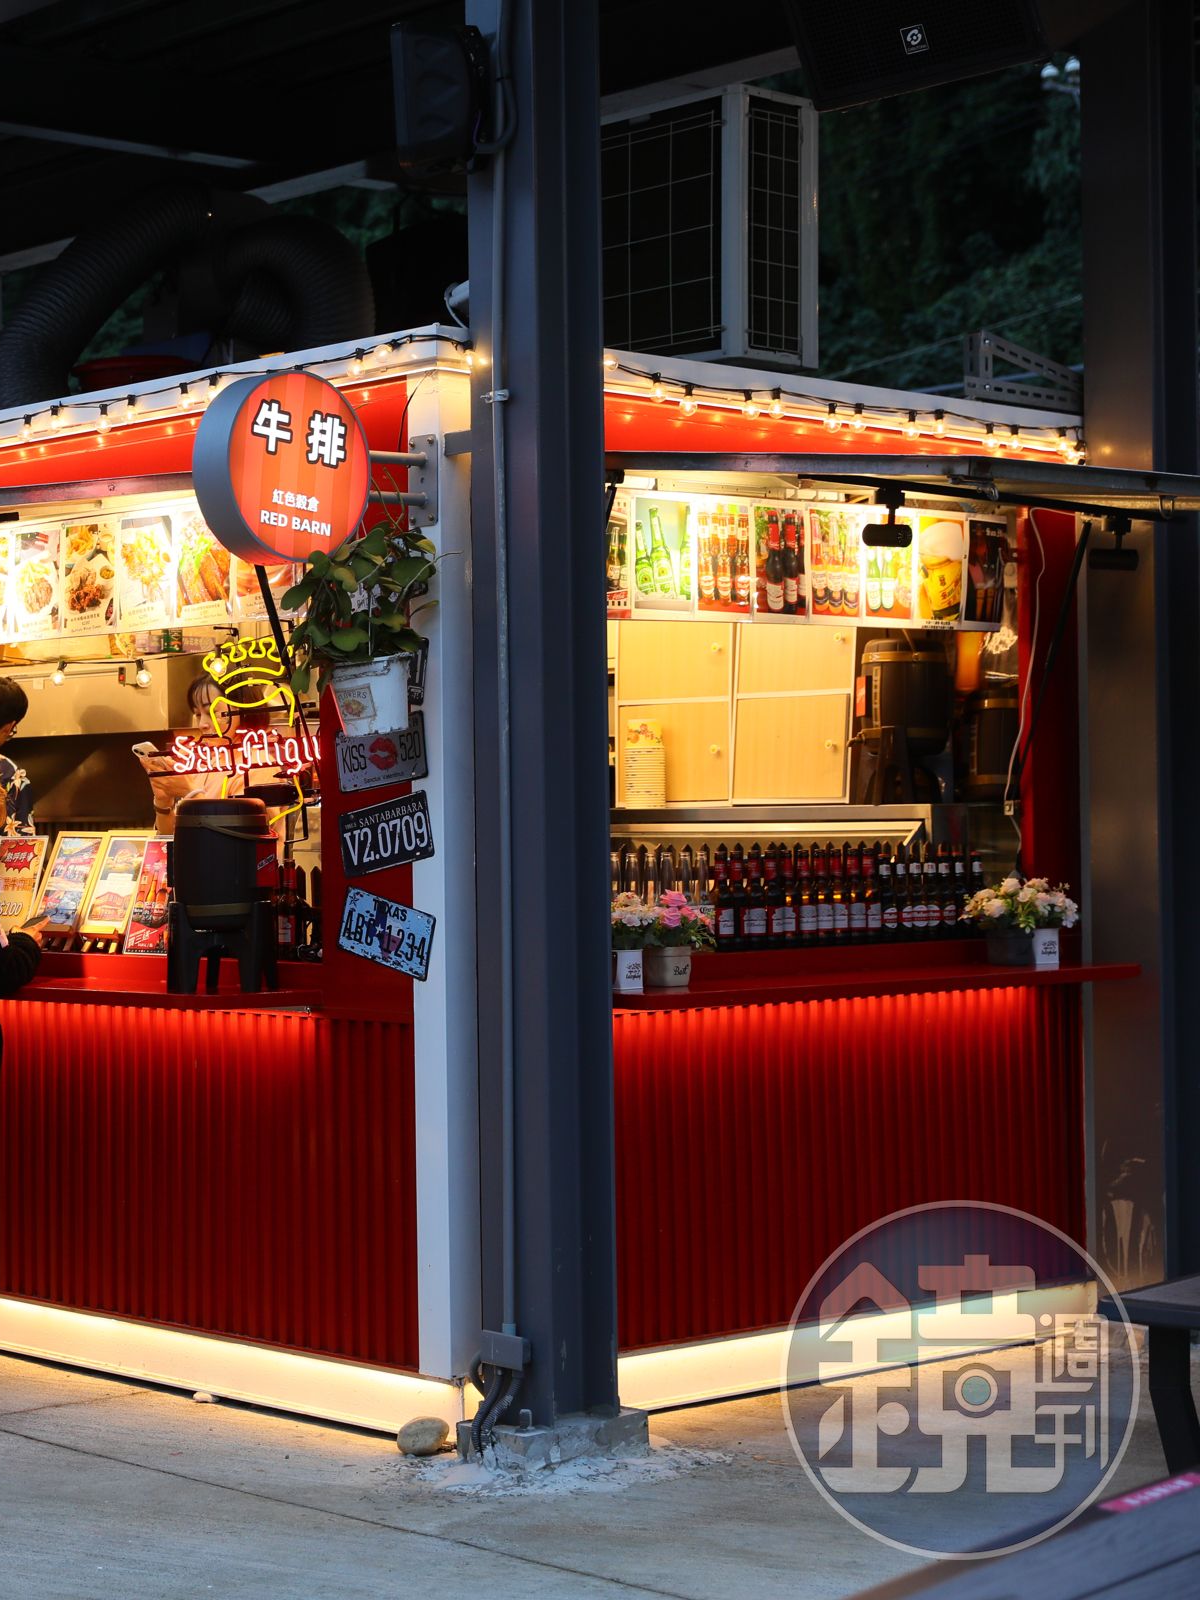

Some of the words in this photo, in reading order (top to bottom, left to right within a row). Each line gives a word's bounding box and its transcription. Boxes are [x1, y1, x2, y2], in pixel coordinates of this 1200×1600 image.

[252, 400, 347, 469] 牛排
[272, 489, 320, 513] 紅色穀倉
[260, 510, 288, 528] RED
[291, 517, 332, 537] BARN
[172, 735, 232, 773] San
[341, 743, 368, 774] KISS
[399, 731, 421, 761] 520
[358, 801, 424, 828] SANTABARBARA
[343, 811, 429, 867] V2.0709
